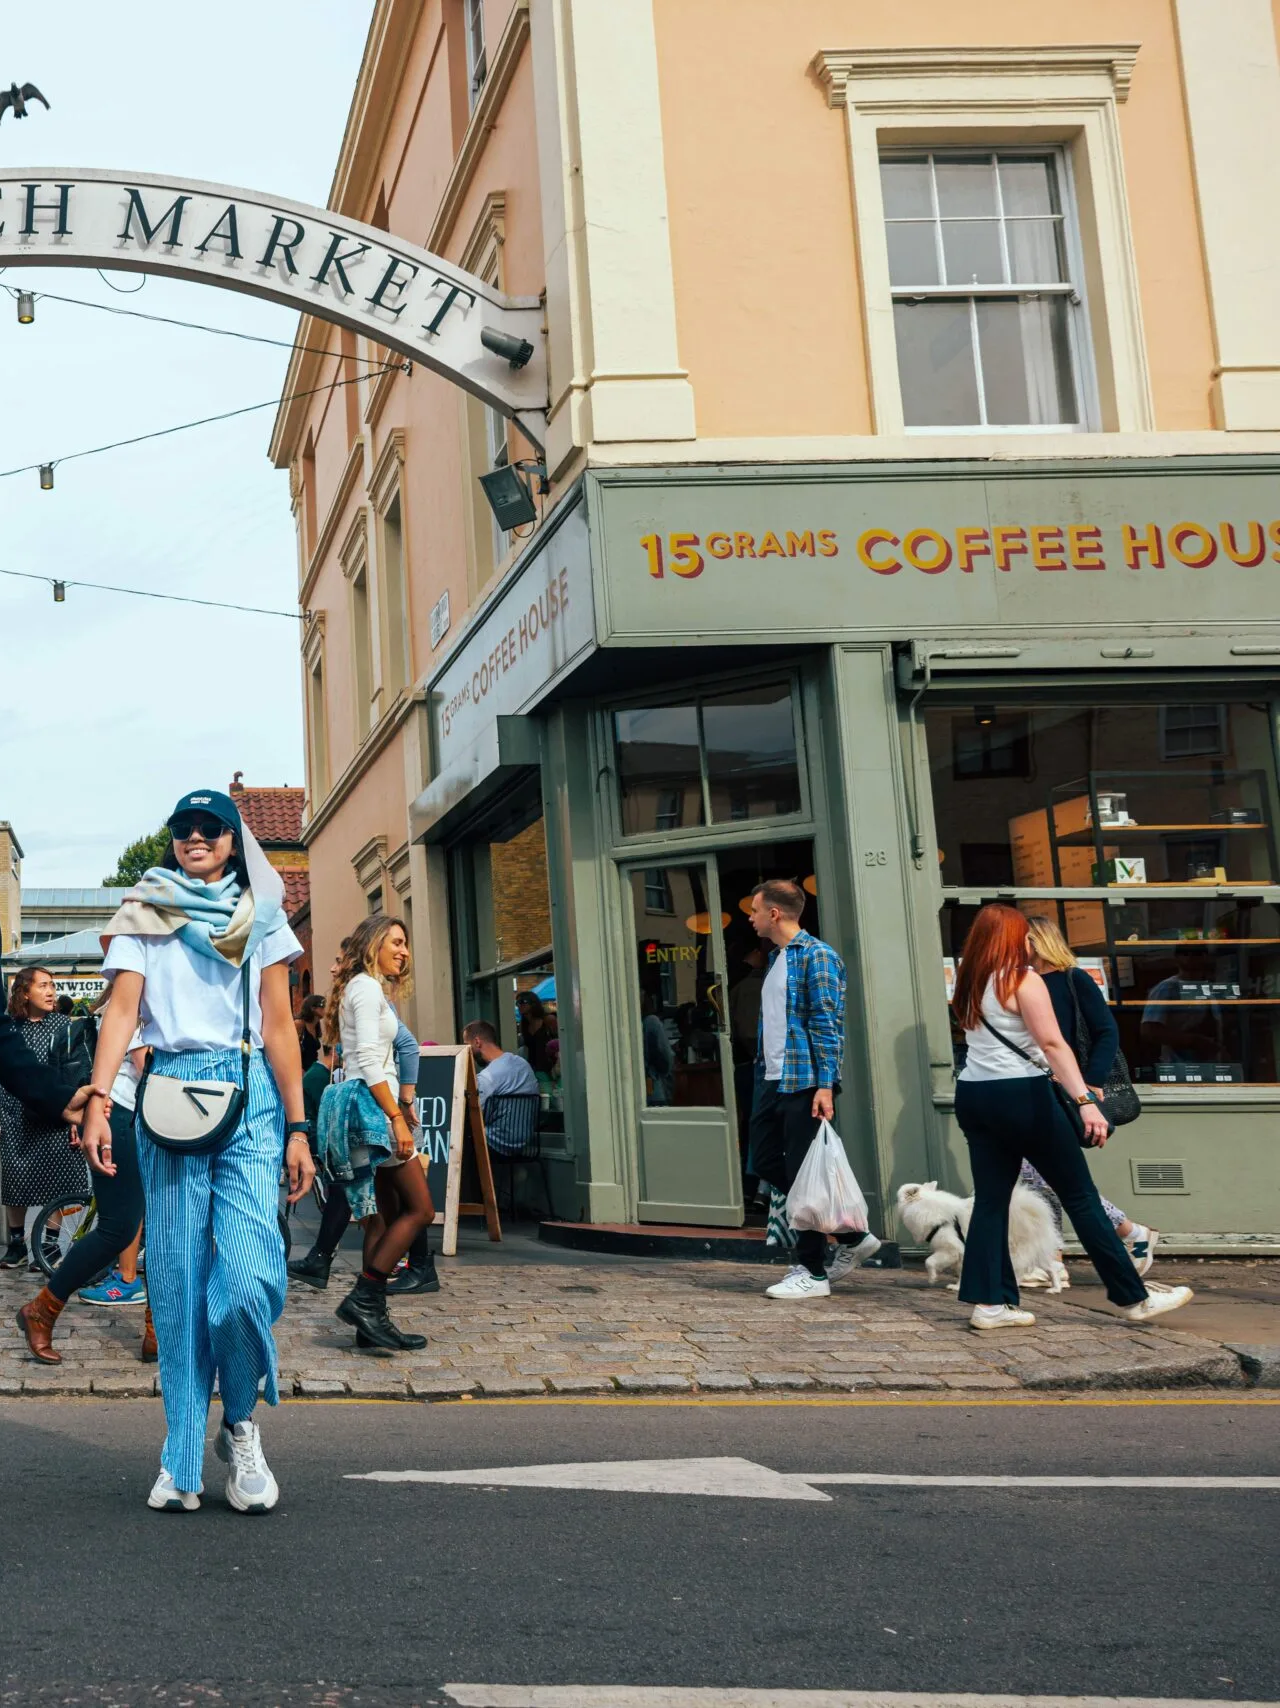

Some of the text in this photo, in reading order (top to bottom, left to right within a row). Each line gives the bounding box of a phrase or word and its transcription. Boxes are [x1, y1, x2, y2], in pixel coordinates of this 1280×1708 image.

[116, 187, 477, 336] MARKET
[856, 525, 1106, 575] COFFEE
[472, 627, 517, 704] COFFEE
[518, 567, 569, 655] HOUSE
[864, 850, 888, 867] 28
[646, 945, 703, 963] ENTRY
